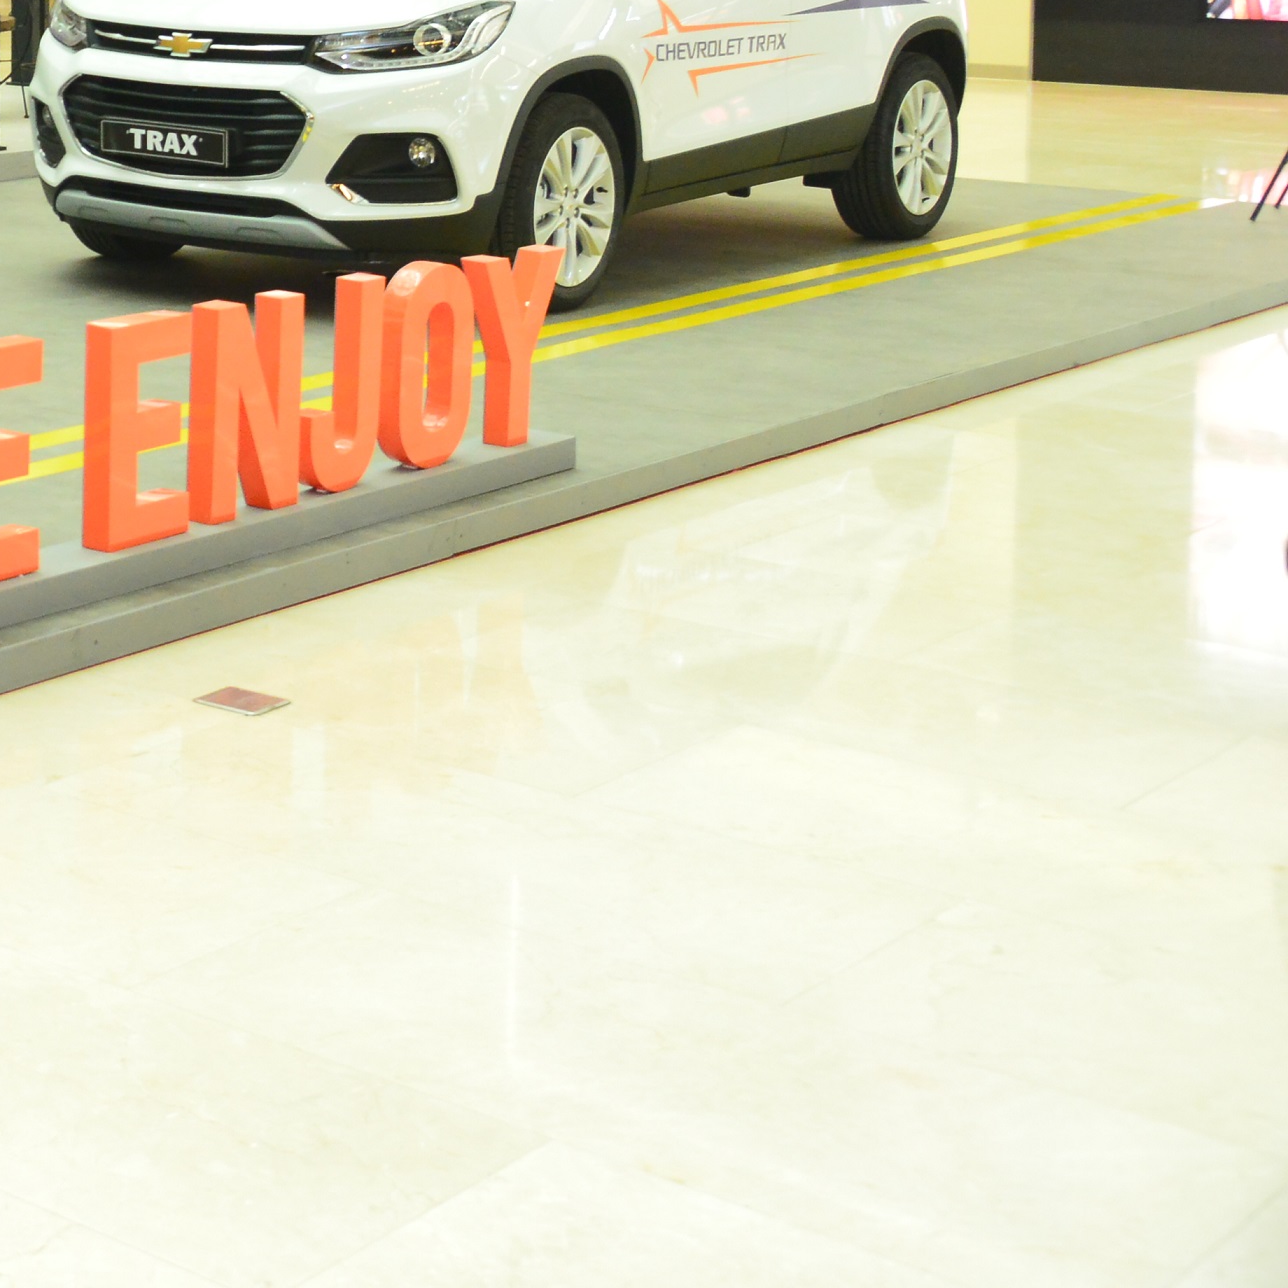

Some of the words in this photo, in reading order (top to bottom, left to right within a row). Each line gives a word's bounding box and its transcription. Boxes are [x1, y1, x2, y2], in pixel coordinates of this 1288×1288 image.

[655, 37, 744, 62] CHEVROLET
[747, 32, 787, 53] TRAX
[127, 127, 199, 156] TRAX
[82, 243, 565, 552] ENJOY
